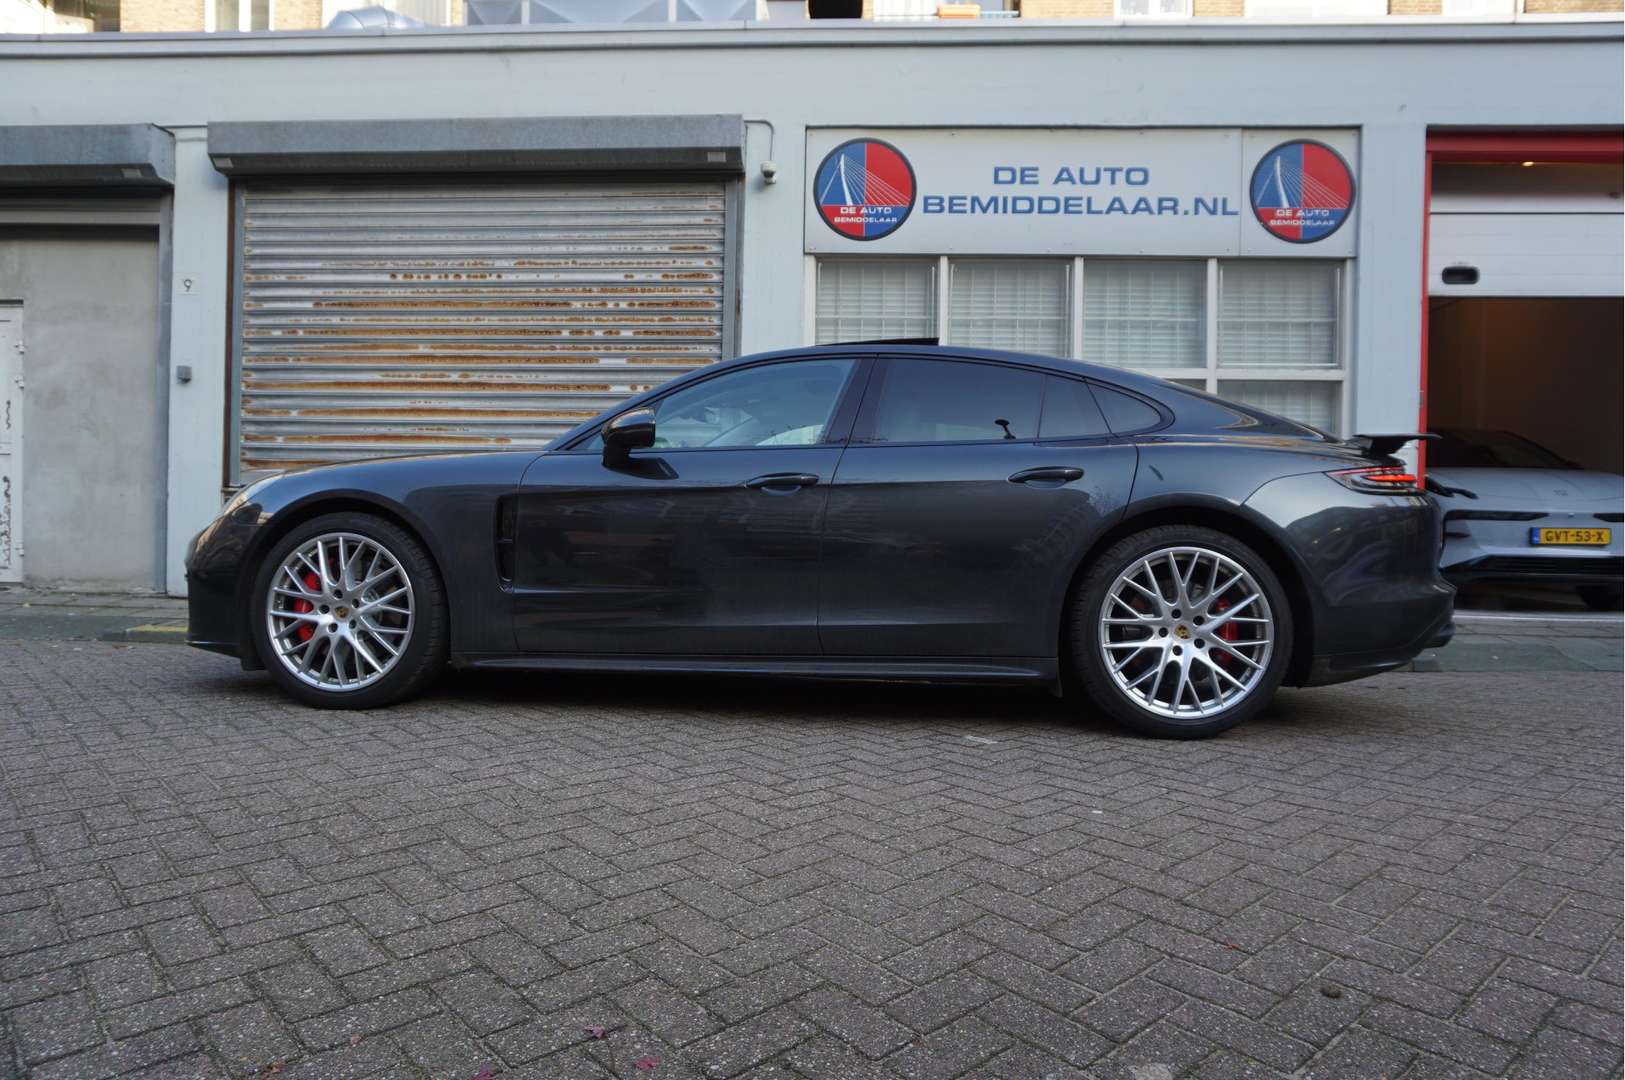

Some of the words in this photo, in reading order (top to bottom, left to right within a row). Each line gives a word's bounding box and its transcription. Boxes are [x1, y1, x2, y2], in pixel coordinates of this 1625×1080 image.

[993, 166, 1040, 185] DE
[1052, 167, 1150, 186] AUTO
[840, 206, 857, 214] DE
[860, 206, 892, 214] AUTO
[922, 195, 1240, 216] BEMIDDELAAR.NL
[1275, 209, 1293, 217] DE
[1296, 209, 1330, 217] AUTO
[1545, 530, 1604, 542] GVT-53-X
